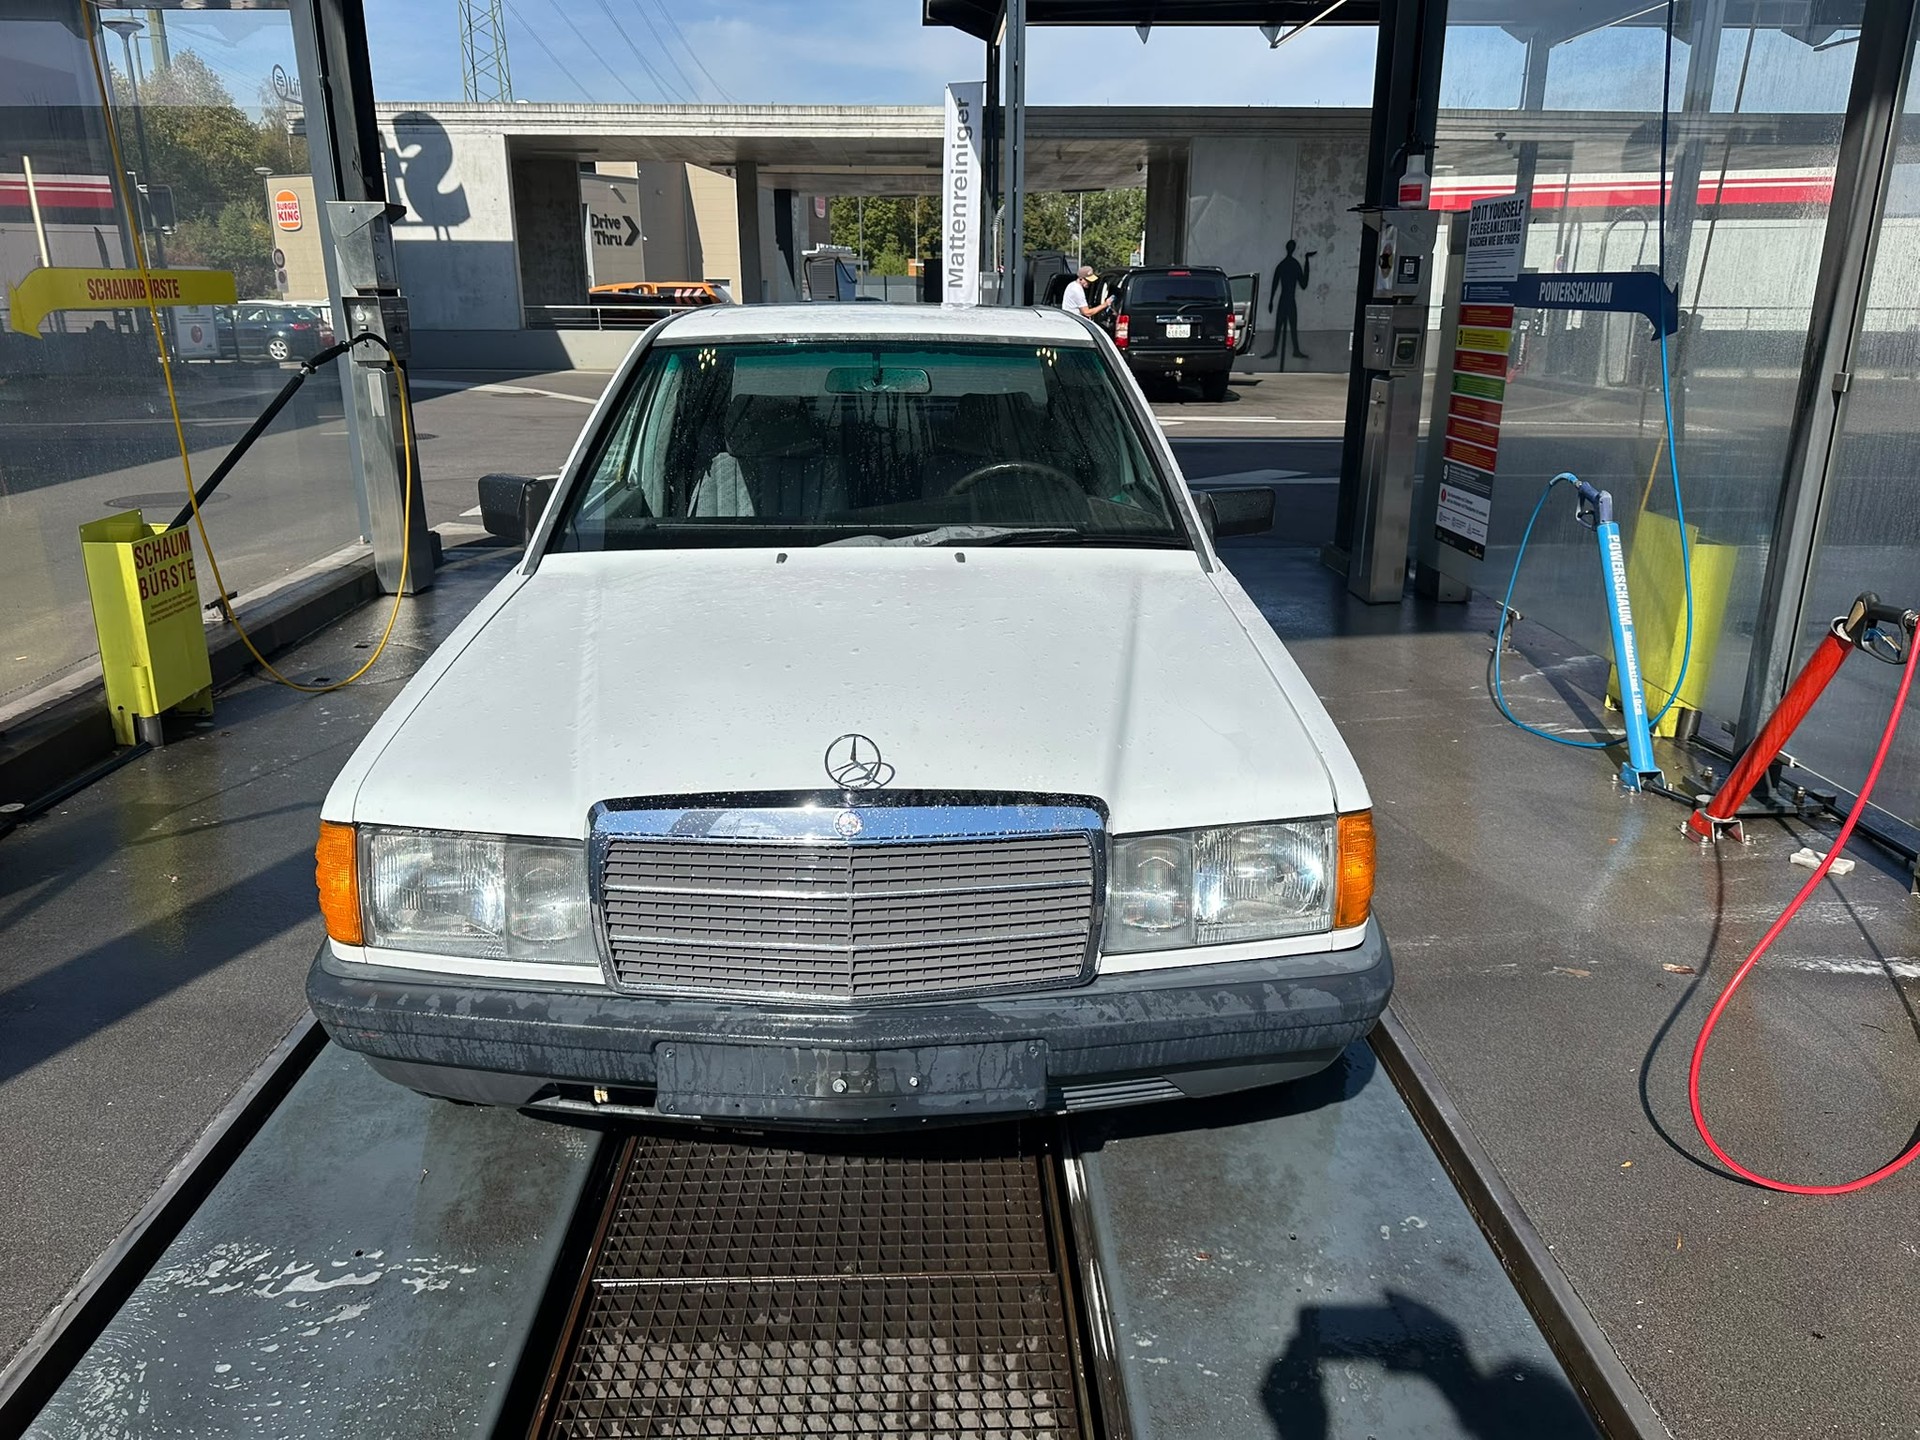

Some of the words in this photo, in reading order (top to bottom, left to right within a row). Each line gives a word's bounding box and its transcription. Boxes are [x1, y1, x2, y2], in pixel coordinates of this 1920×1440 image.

[948, 97, 973, 289] Mattenreiniger
[276, 202, 298, 211] BURGER
[278, 210, 299, 222] KING
[1471, 206, 1481, 222] DO
[1489, 199, 1524, 220] YOURSELF
[591, 213, 621, 230] Drive
[1470, 218, 1522, 236] PFLEGEANLEITUNG
[594, 230, 622, 246] Thru
[1538, 281, 1613, 304] POWERSCHAUM
[134, 529, 192, 571] SCHAUM
[138, 558, 196, 601] BÜRSTE
[1607, 534, 1633, 626] POWERSCHAUM
